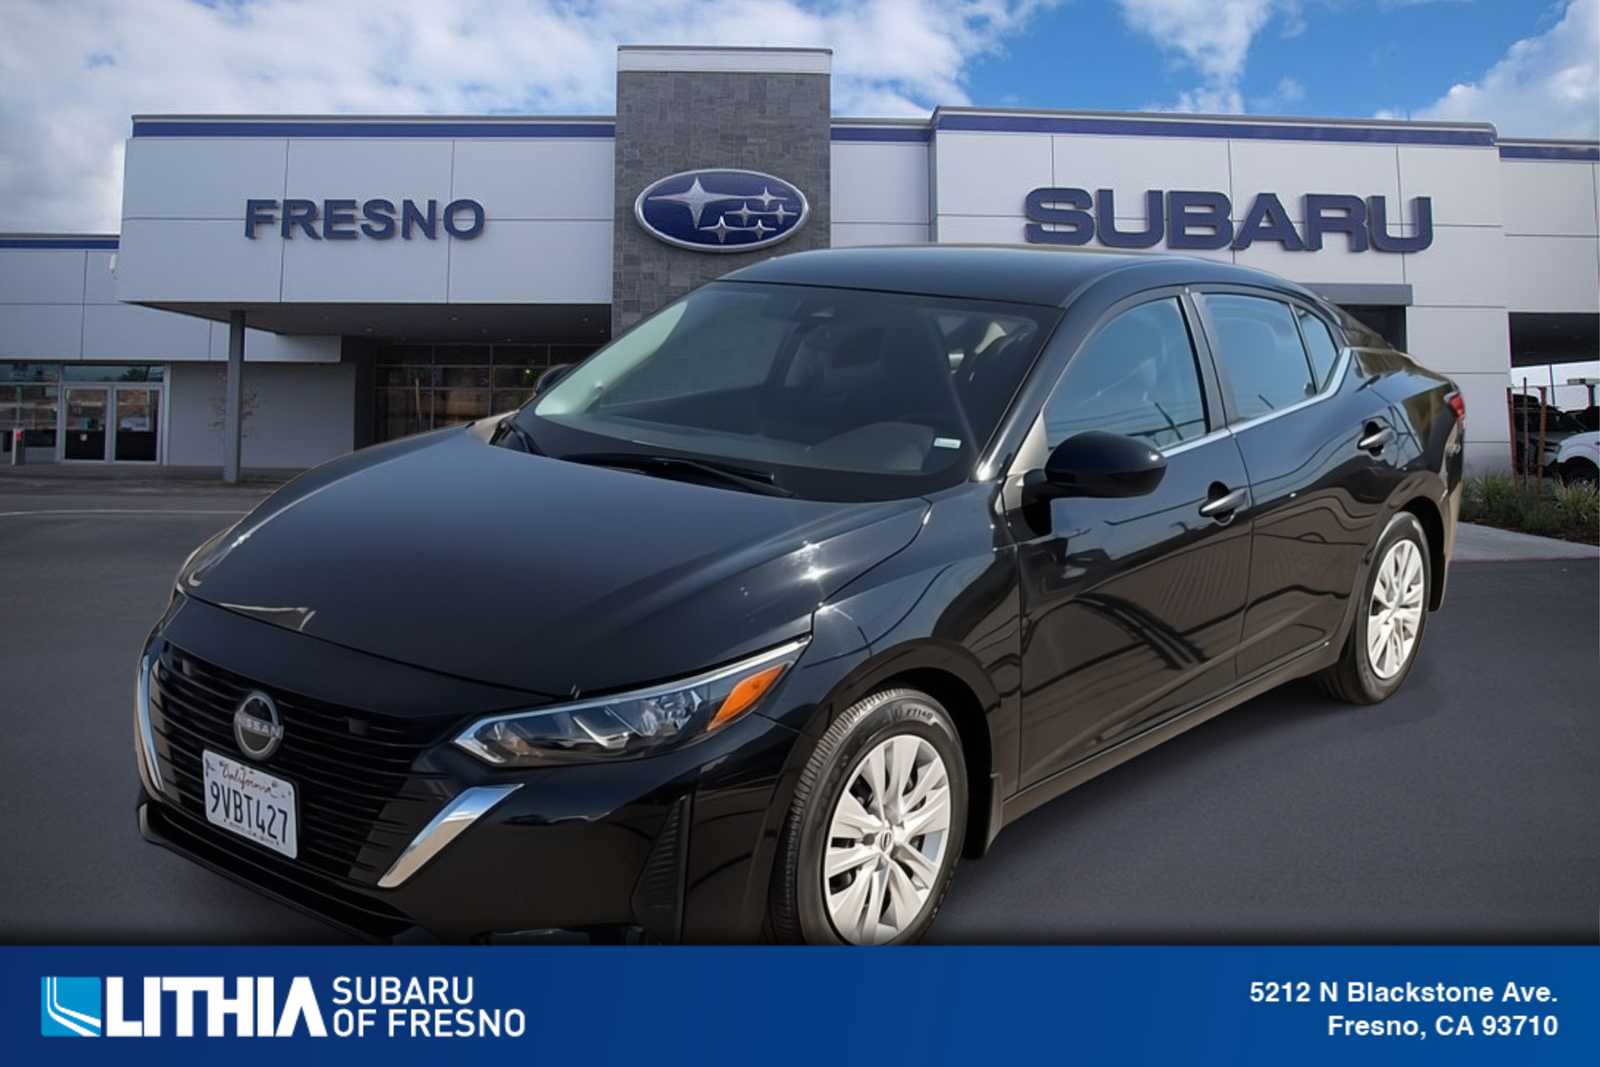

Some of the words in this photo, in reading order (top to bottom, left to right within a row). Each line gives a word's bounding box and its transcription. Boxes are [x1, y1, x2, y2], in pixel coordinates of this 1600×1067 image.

[245, 199, 485, 240] FRESNO
[1025, 187, 1433, 253] SUBARU
[237, 715, 281, 737] NISSAN
[222, 764, 273, 793] California
[210, 780, 288, 844] 9VBT427
